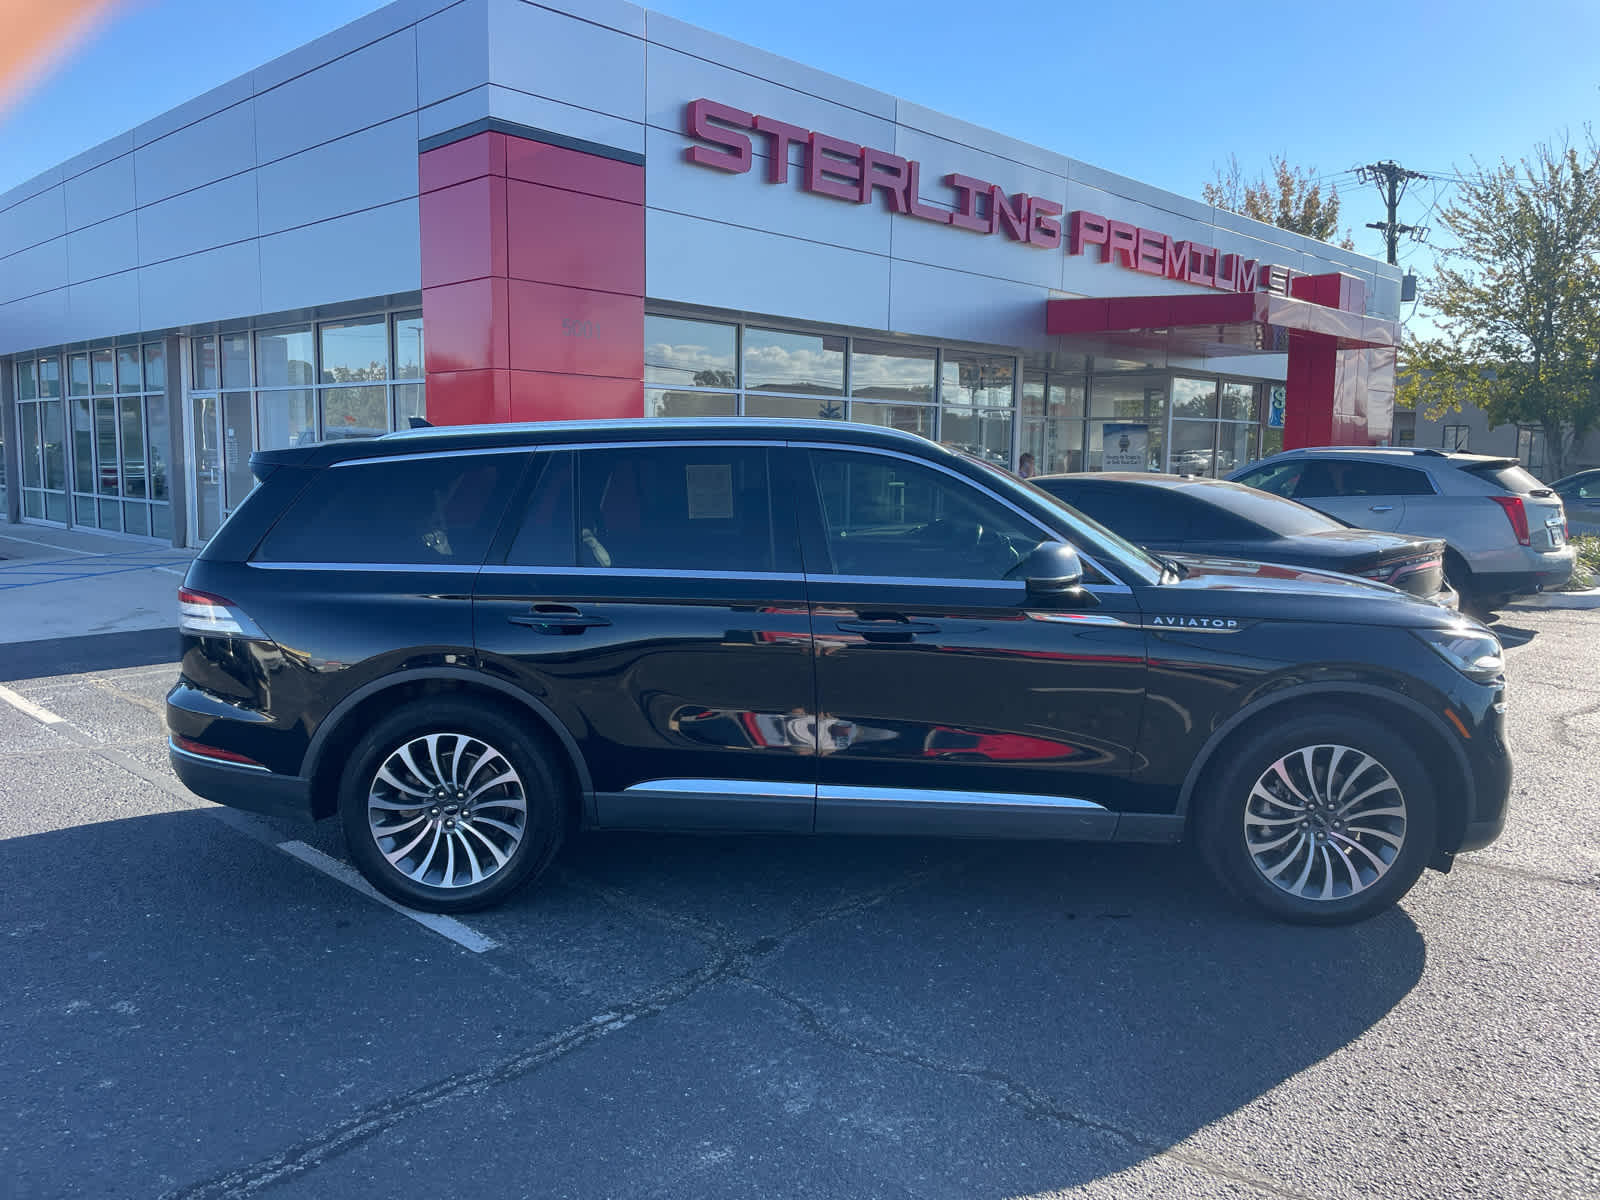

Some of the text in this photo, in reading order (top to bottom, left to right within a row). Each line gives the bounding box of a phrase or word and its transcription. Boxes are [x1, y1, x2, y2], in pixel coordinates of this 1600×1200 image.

[685, 98, 1063, 249] STERLING
[1070, 210, 1258, 293] PREMIUM
[1153, 616, 1237, 627] AVIATOR
